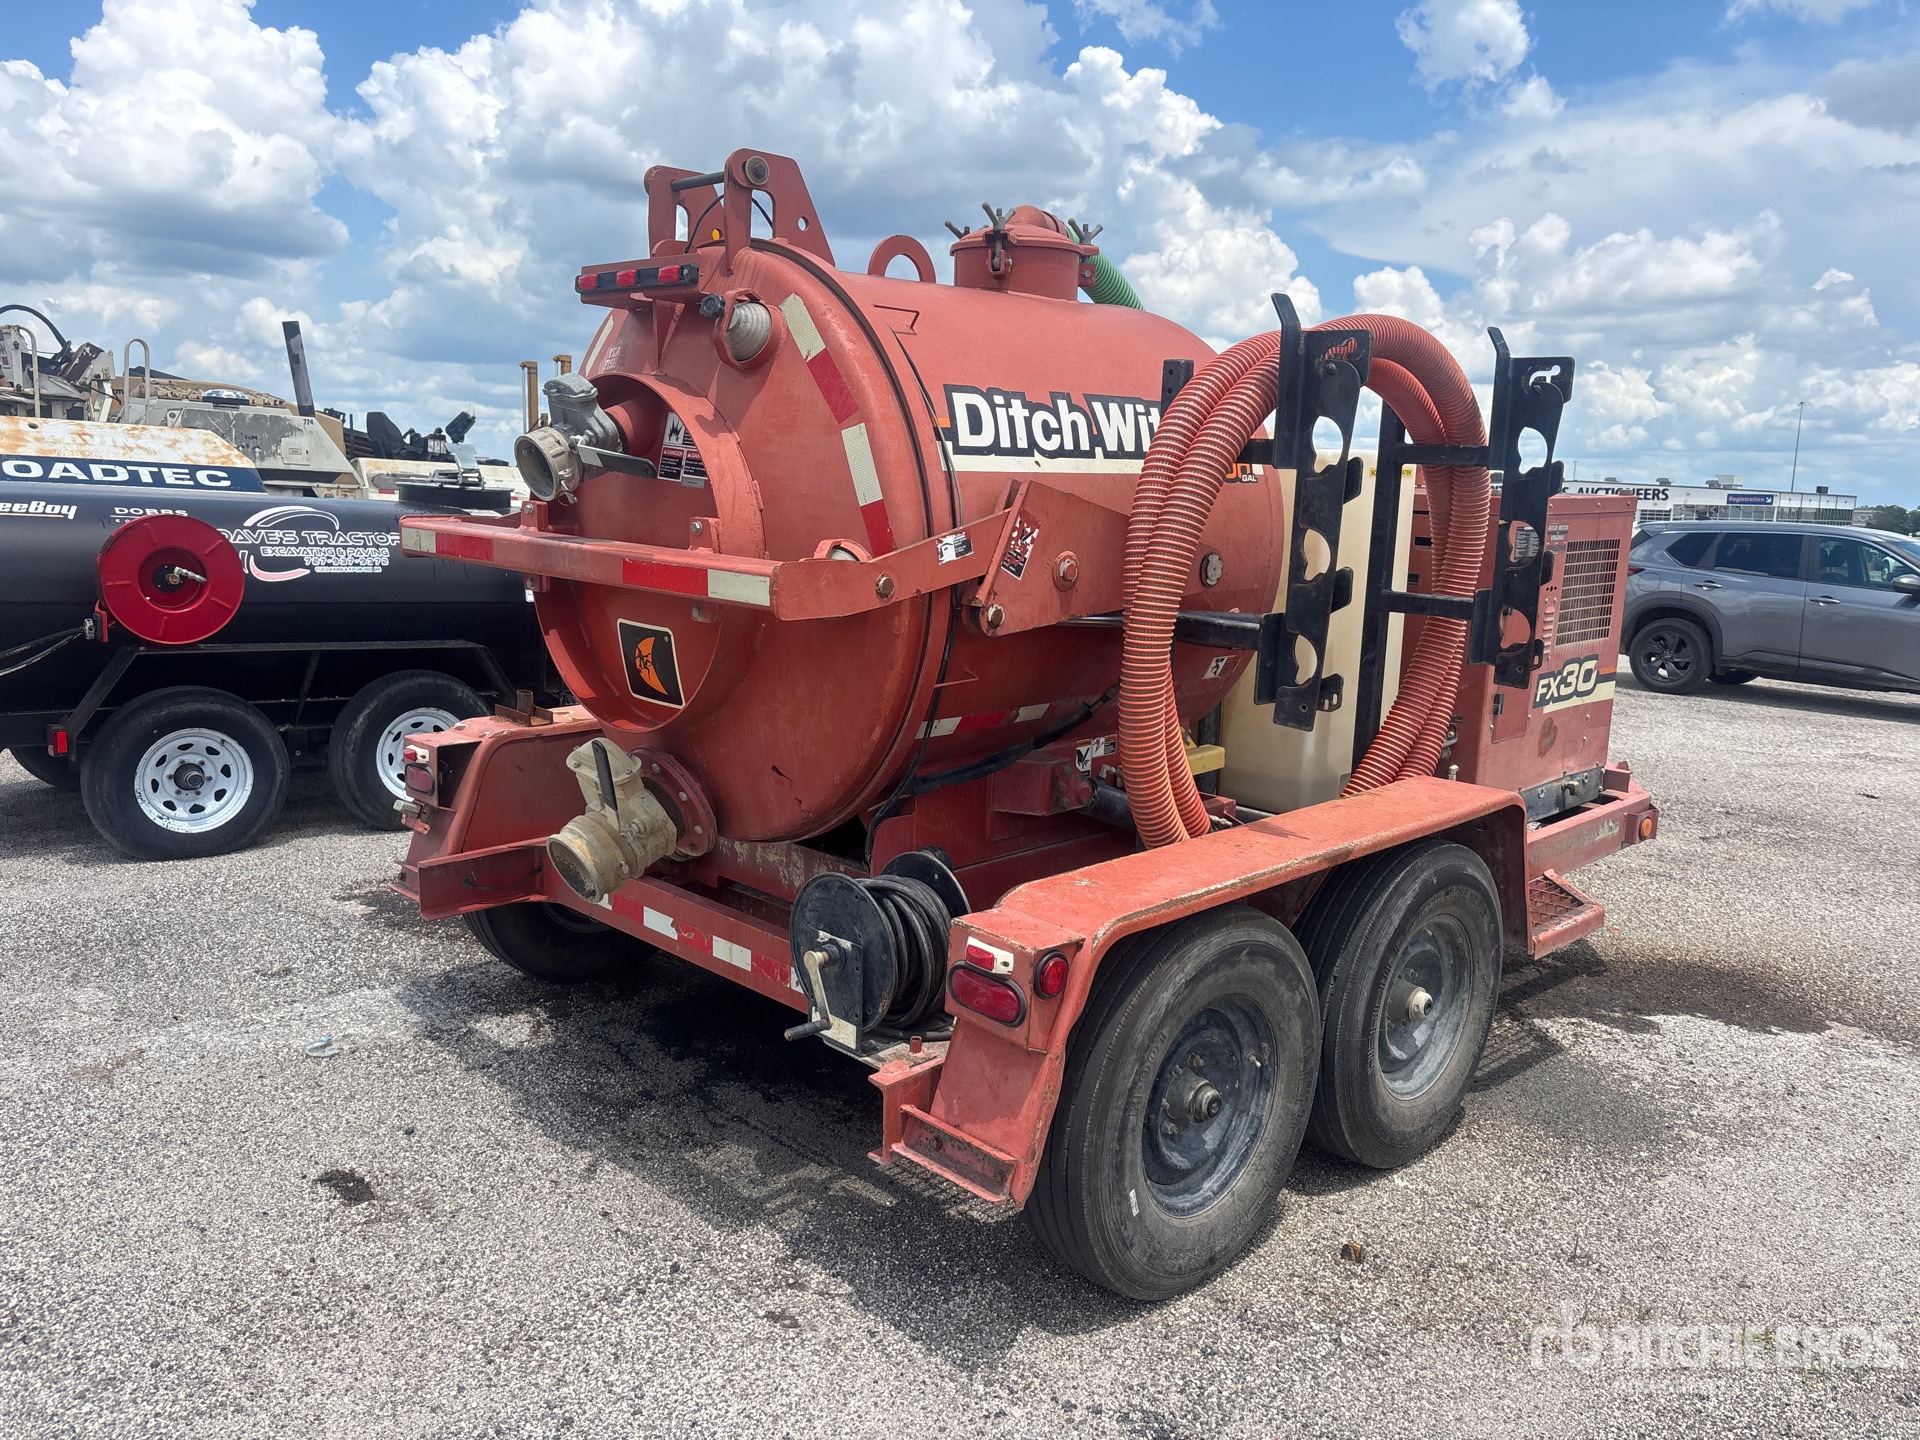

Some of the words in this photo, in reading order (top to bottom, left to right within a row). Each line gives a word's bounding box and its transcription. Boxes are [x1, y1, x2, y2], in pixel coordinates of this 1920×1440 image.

[952, 392, 1090, 452] Ditch
[1241, 474, 1258, 482] GAL
[1728, 495, 1765, 503] Registration
[260, 546, 335, 557] EXCAVATING
[336, 547, 346, 557] &
[347, 547, 390, 557] PAVING
[1535, 659, 1599, 702] FX30
